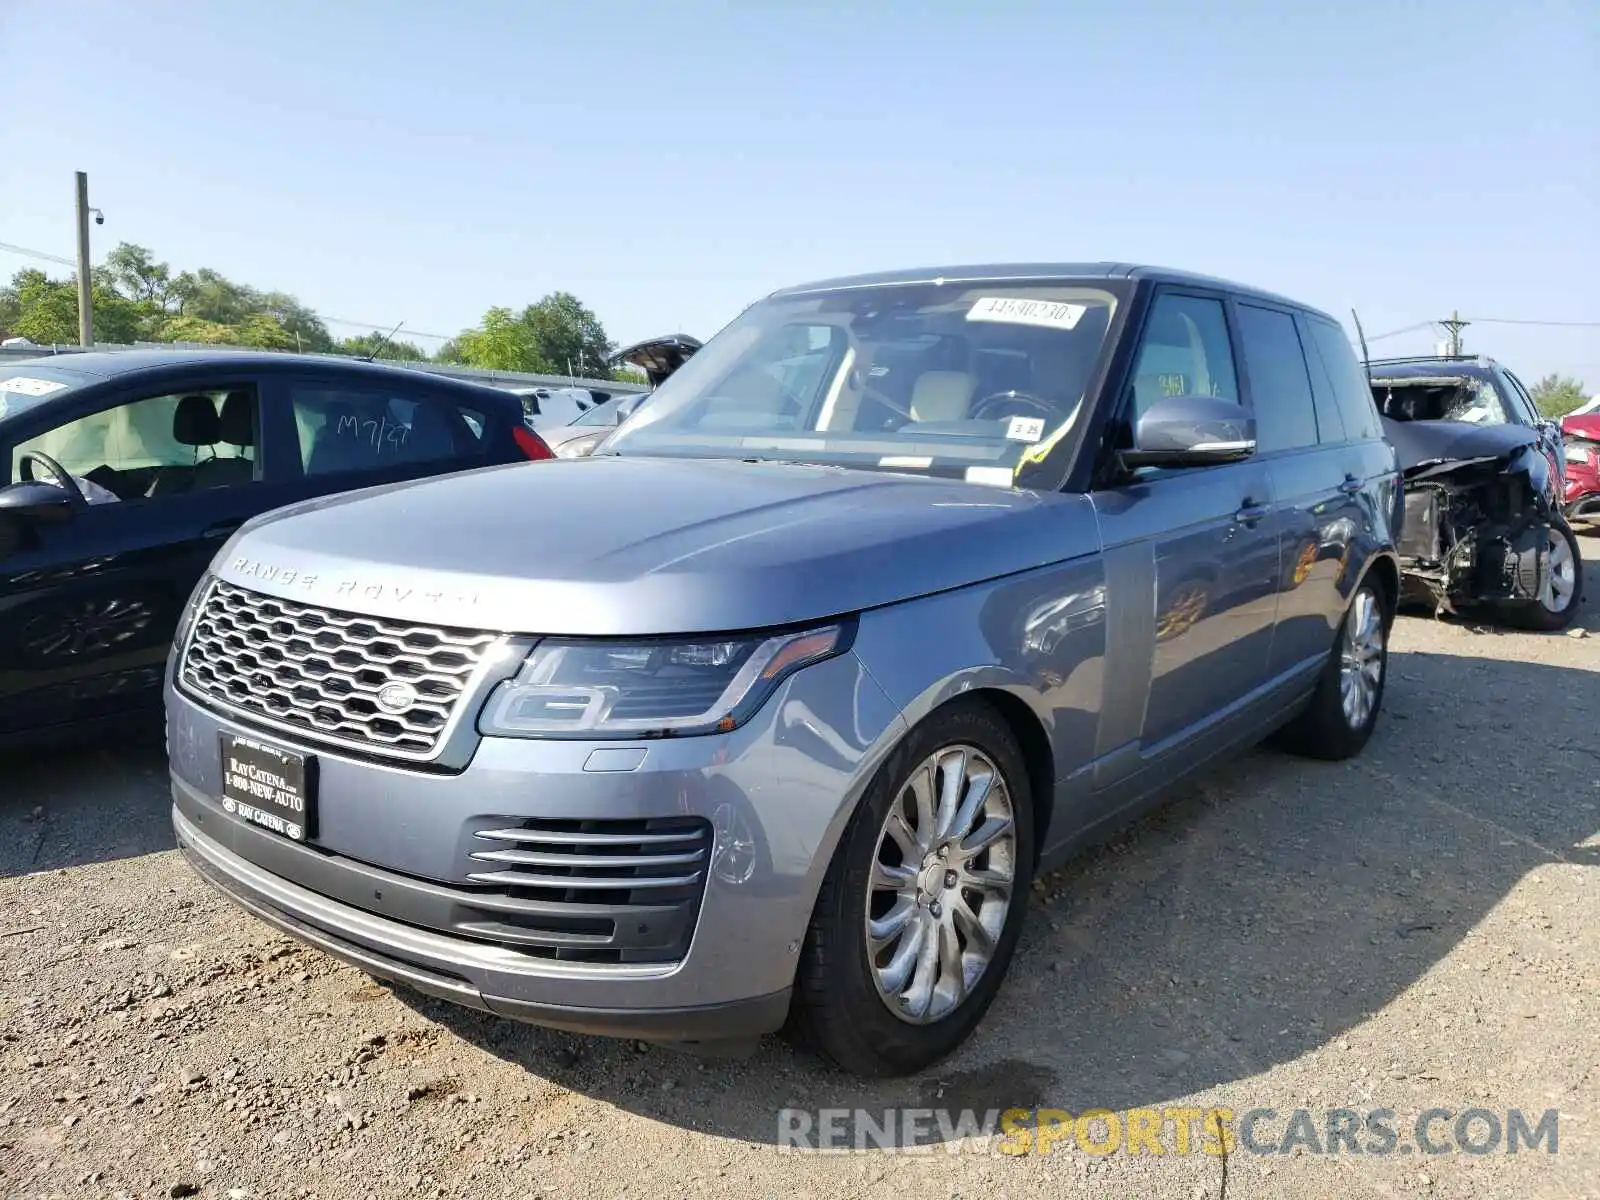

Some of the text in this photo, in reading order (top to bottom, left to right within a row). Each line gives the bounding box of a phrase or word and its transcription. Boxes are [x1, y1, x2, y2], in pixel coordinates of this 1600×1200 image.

[336, 577, 480, 605] ROV
[225, 771, 303, 812] 1-800-NEW-AUTO
[238, 803, 253, 819] RAY
[254, 810, 284, 833] CATENA
